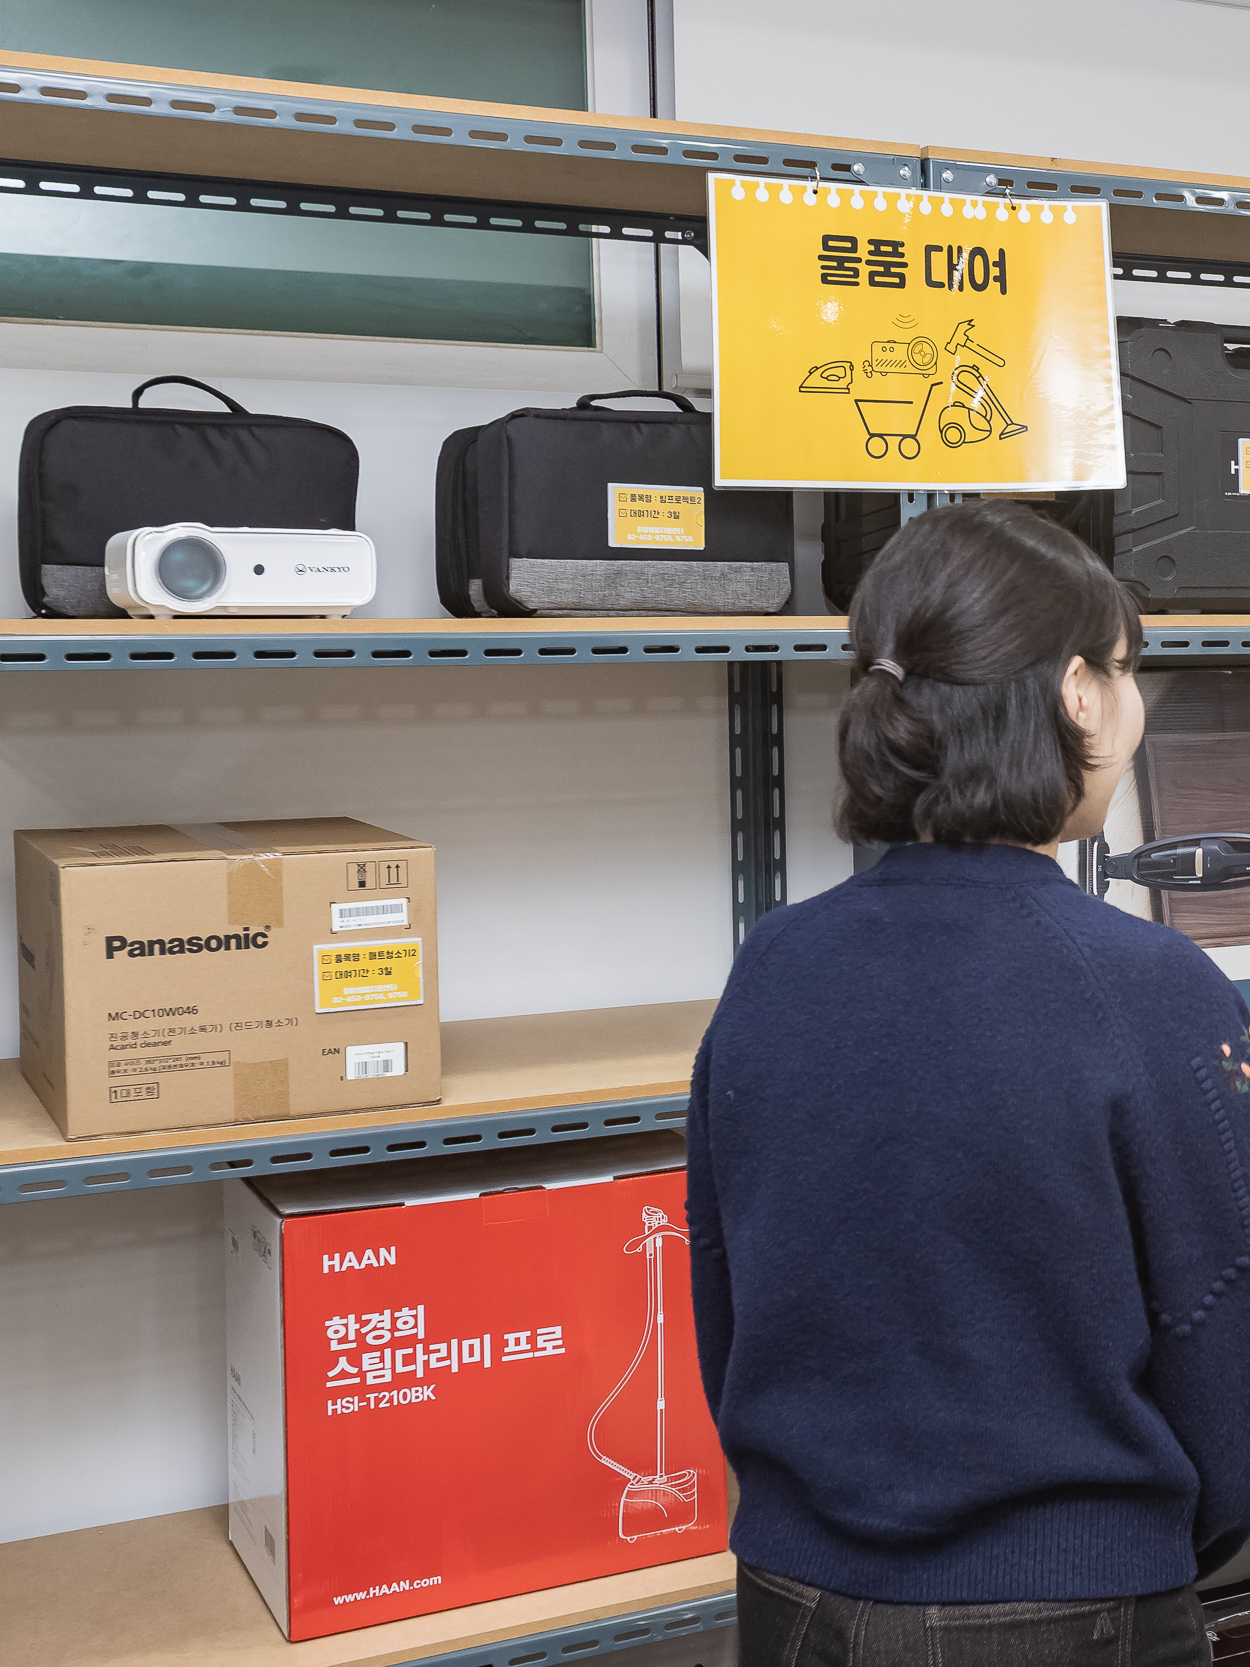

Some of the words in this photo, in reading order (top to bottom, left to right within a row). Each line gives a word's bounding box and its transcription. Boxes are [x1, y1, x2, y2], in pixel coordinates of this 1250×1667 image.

[817, 233, 908, 290] 물품
[924, 244, 1008, 296] 대여
[629, 493, 652, 503] 품목명
[659, 494, 702, 505] 빔프로젝트2
[629, 508, 660, 519] 대여기간
[667, 510, 680, 519] 3일
[308, 565, 350, 573] VANKYO
[105, 926, 269, 960] Panasonic
[335, 952, 360, 964] 품목명
[368, 948, 417, 961] 매트청소기2
[335, 968, 370, 980] 대여기간
[377, 966, 393, 976] 3일
[107, 1005, 199, 1022] MC-DC10W046
[139, 1038, 173, 1049] cleaner
[321, 1047, 340, 1056] EAN
[322, 1245, 396, 1274] HAAN
[324, 1304, 426, 1352] 한경희
[325, 1333, 492, 1388] 스팀다리미
[501, 1325, 566, 1362] 프로
[327, 1384, 437, 1416] HSI-T210BK
[332, 1575, 442, 1605] www.HAAN.com
